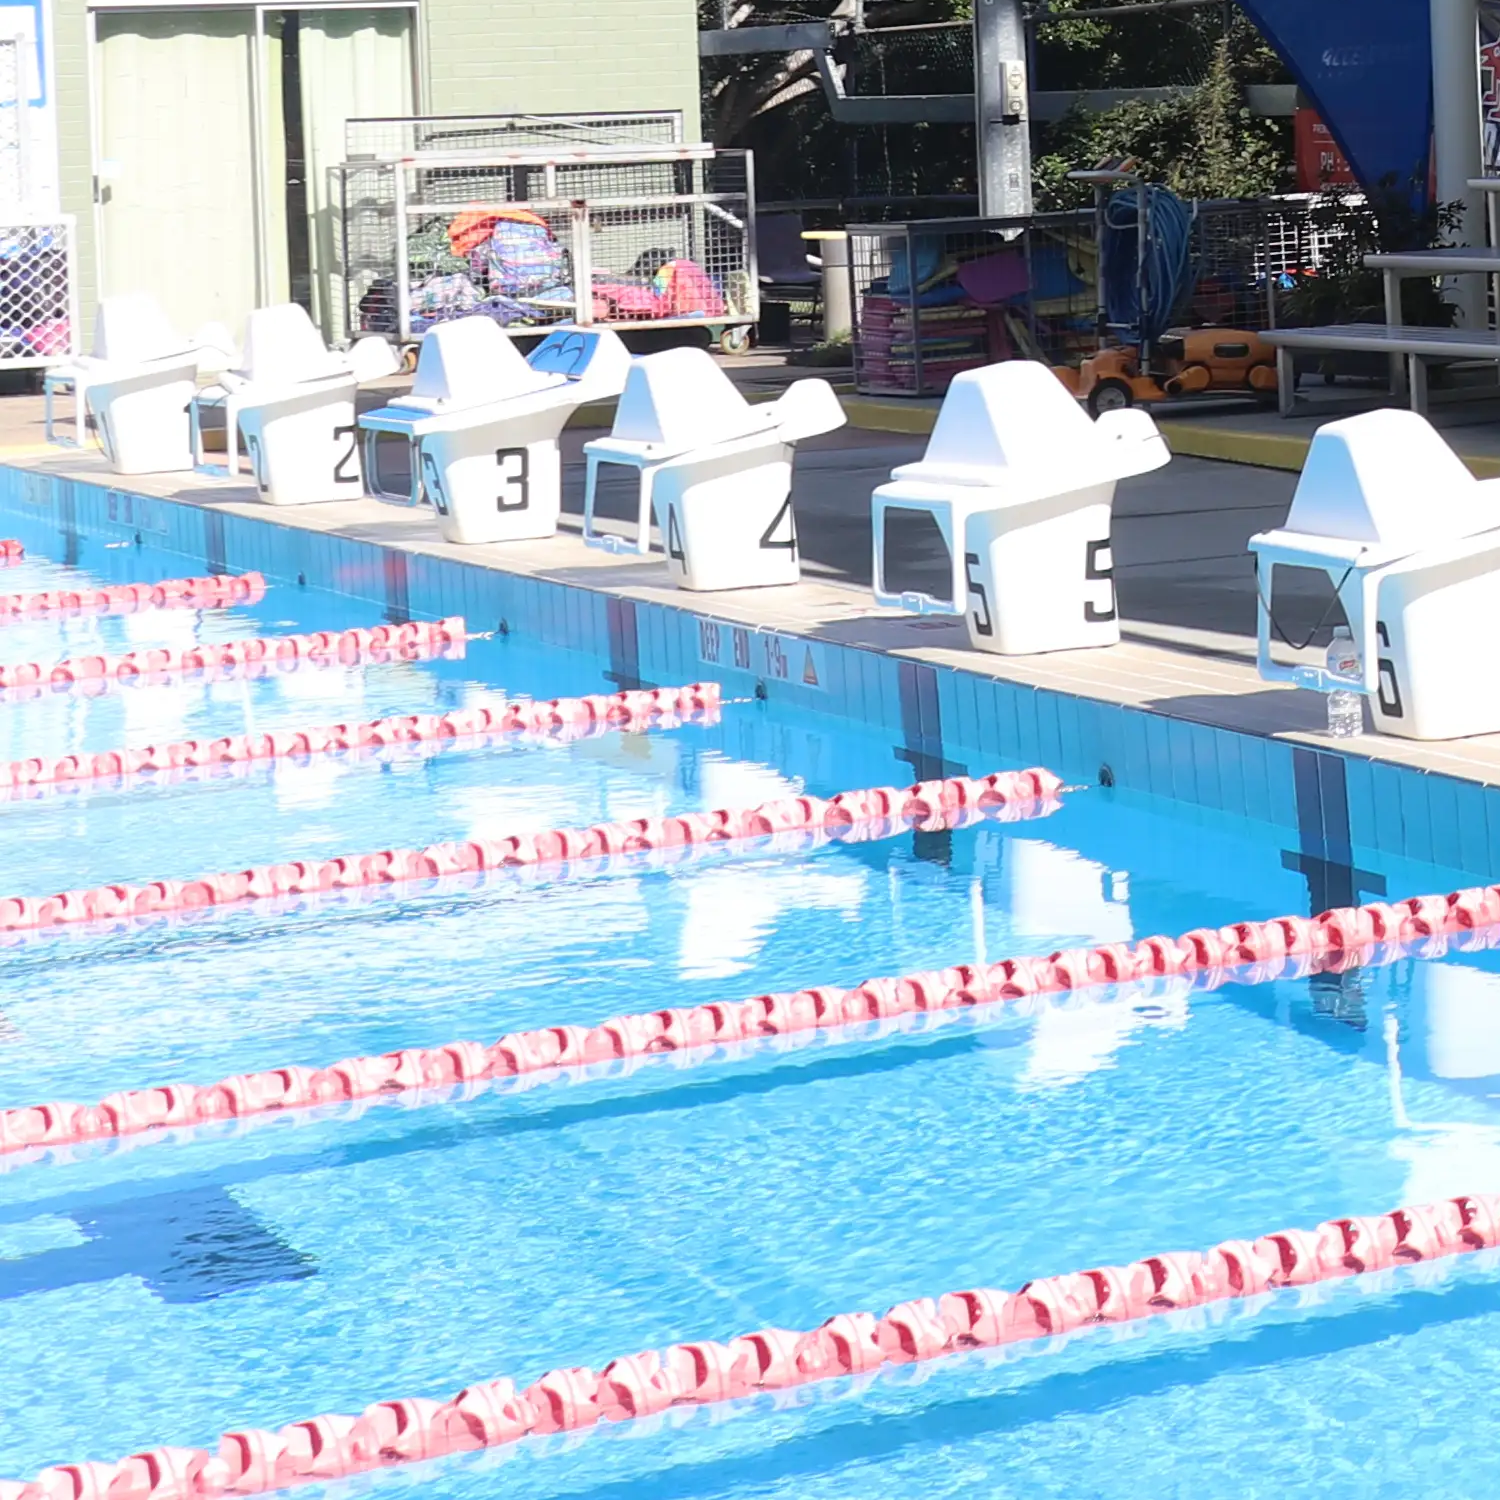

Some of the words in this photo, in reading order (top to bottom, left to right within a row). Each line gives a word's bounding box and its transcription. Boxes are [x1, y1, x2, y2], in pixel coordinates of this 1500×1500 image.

[333, 424, 360, 483] 2
[422, 452, 449, 516] 3
[496, 446, 529, 513] 3
[668, 502, 687, 575] 4
[759, 490, 797, 562] 4
[965, 552, 993, 637] 5
[1084, 538, 1116, 623] 5
